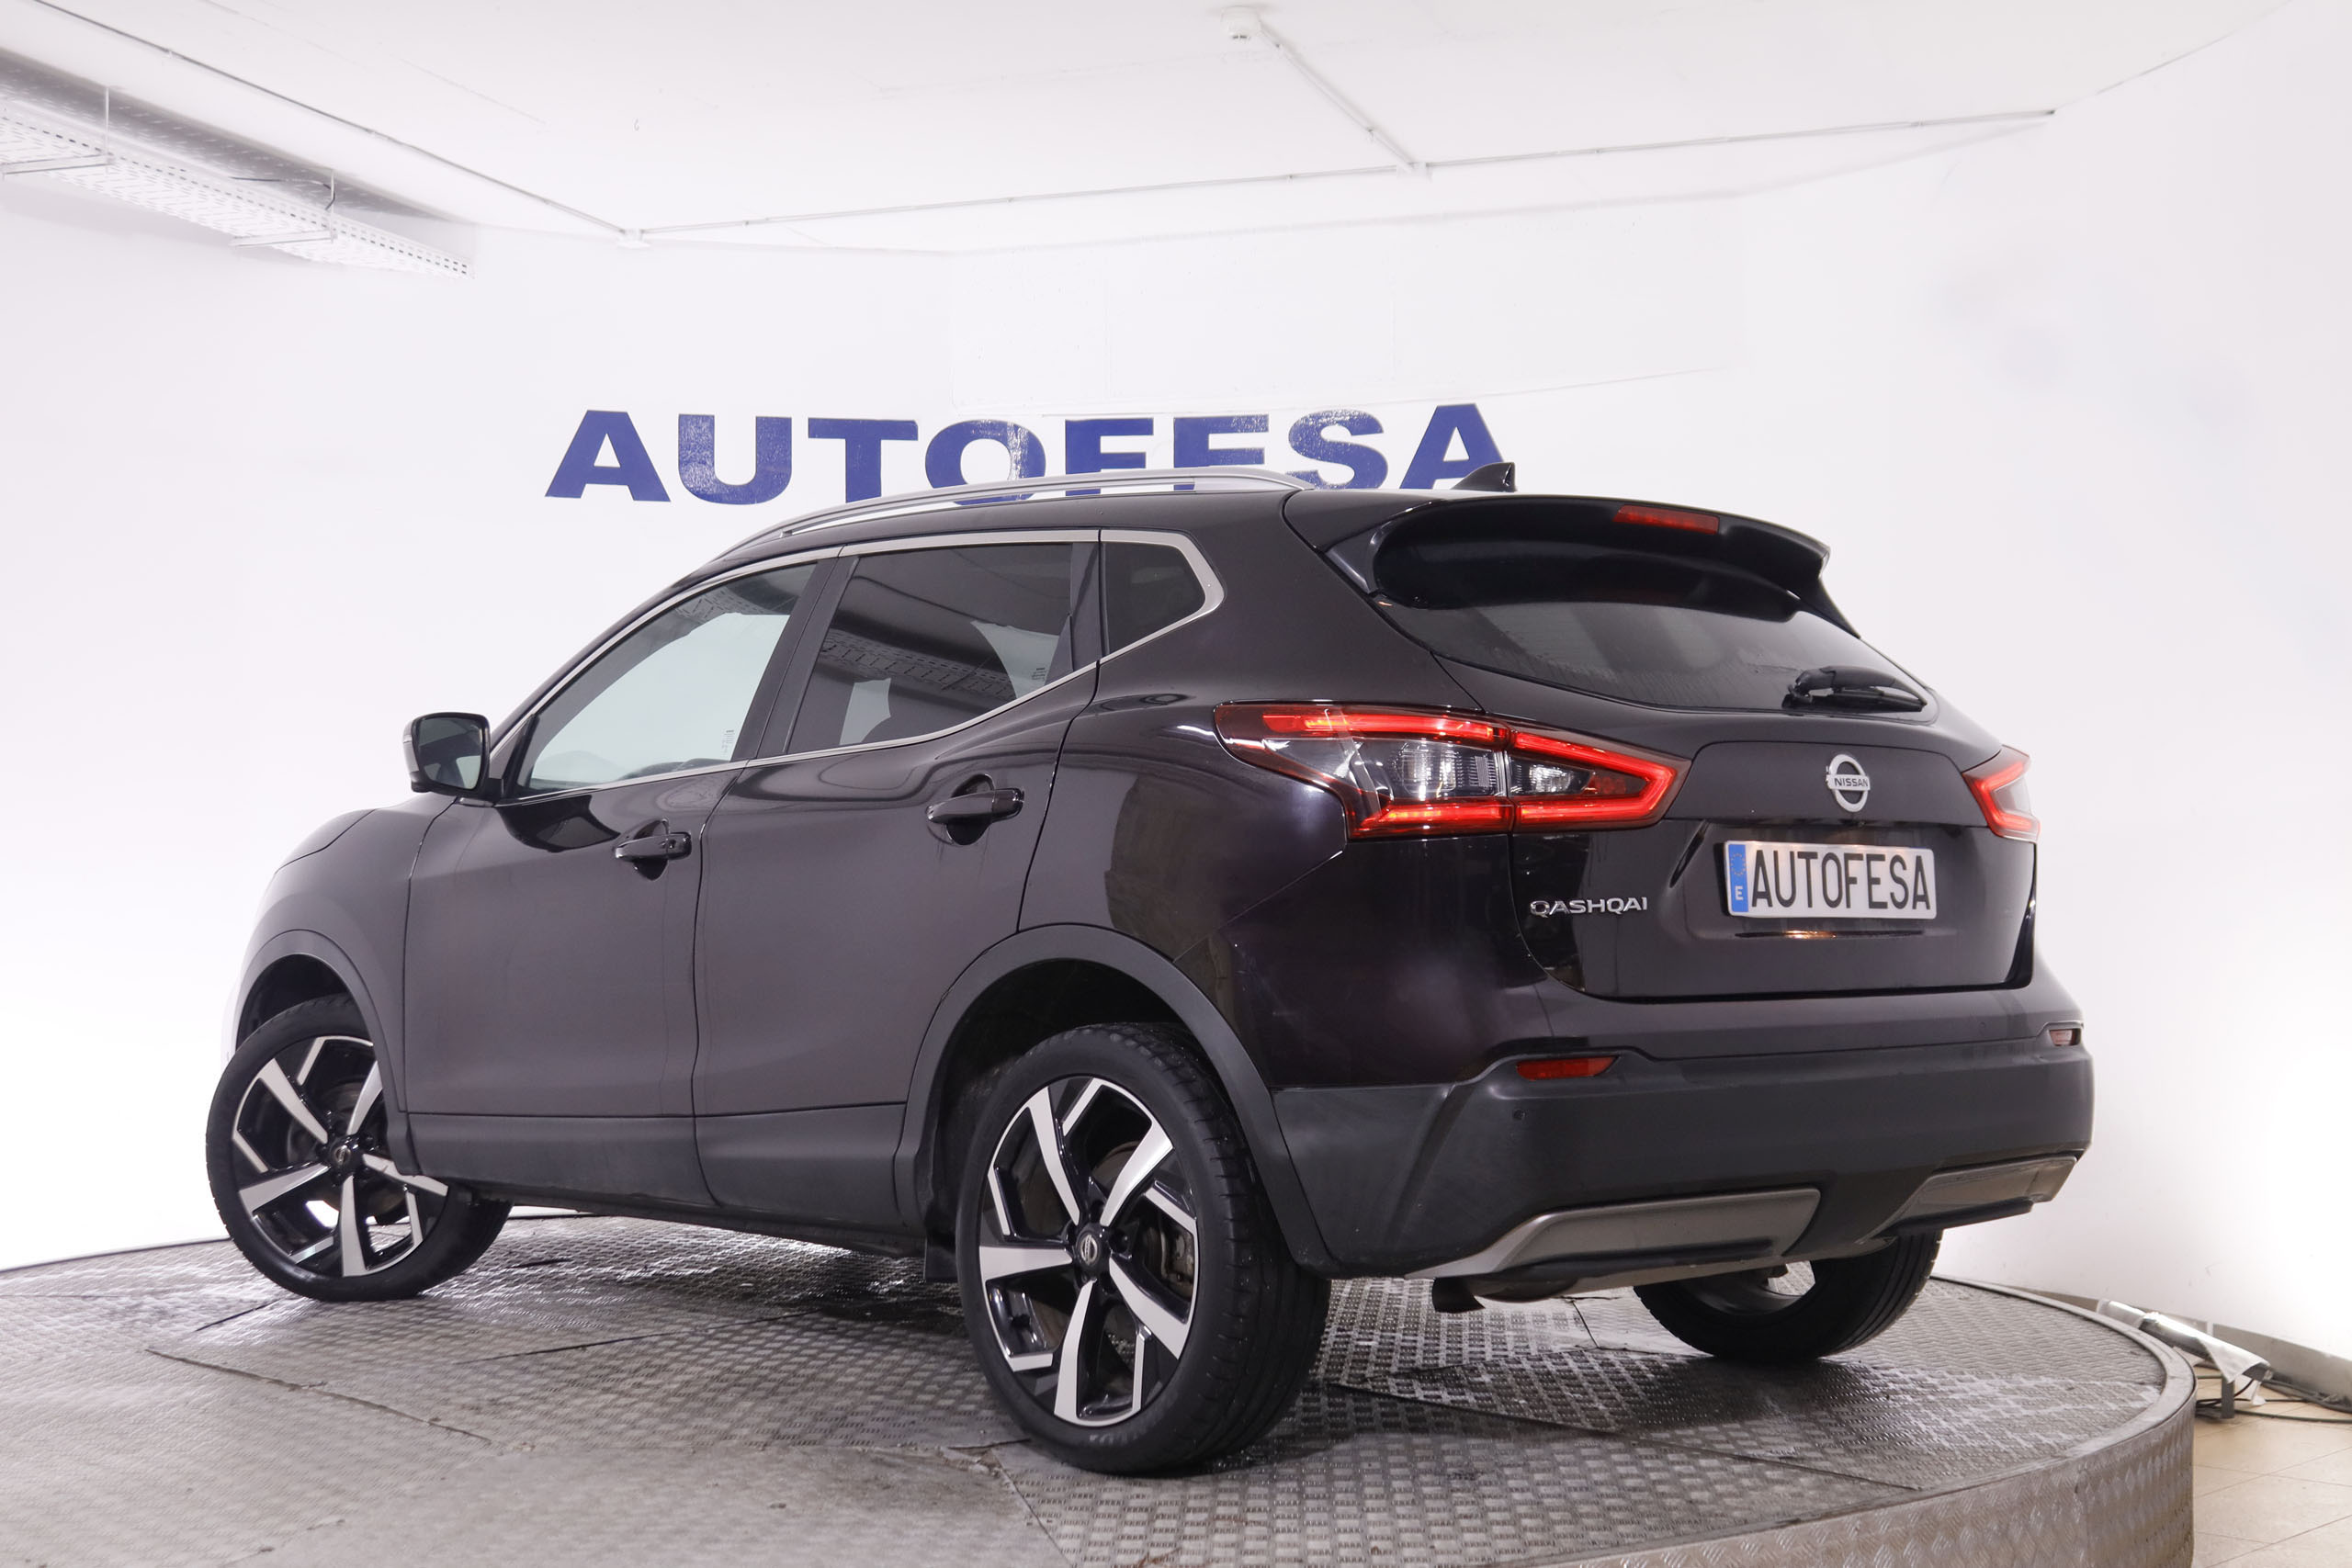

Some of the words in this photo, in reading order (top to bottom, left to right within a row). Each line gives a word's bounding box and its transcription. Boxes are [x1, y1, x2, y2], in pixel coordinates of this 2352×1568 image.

[545, 403, 1505, 505] AUTOFESA
[1834, 777, 1869, 787] NISSAN
[1735, 886, 1744, 901] E
[1751, 849, 1931, 910] AUTOFESA
[1530, 897, 1648, 919] QASHQAI
